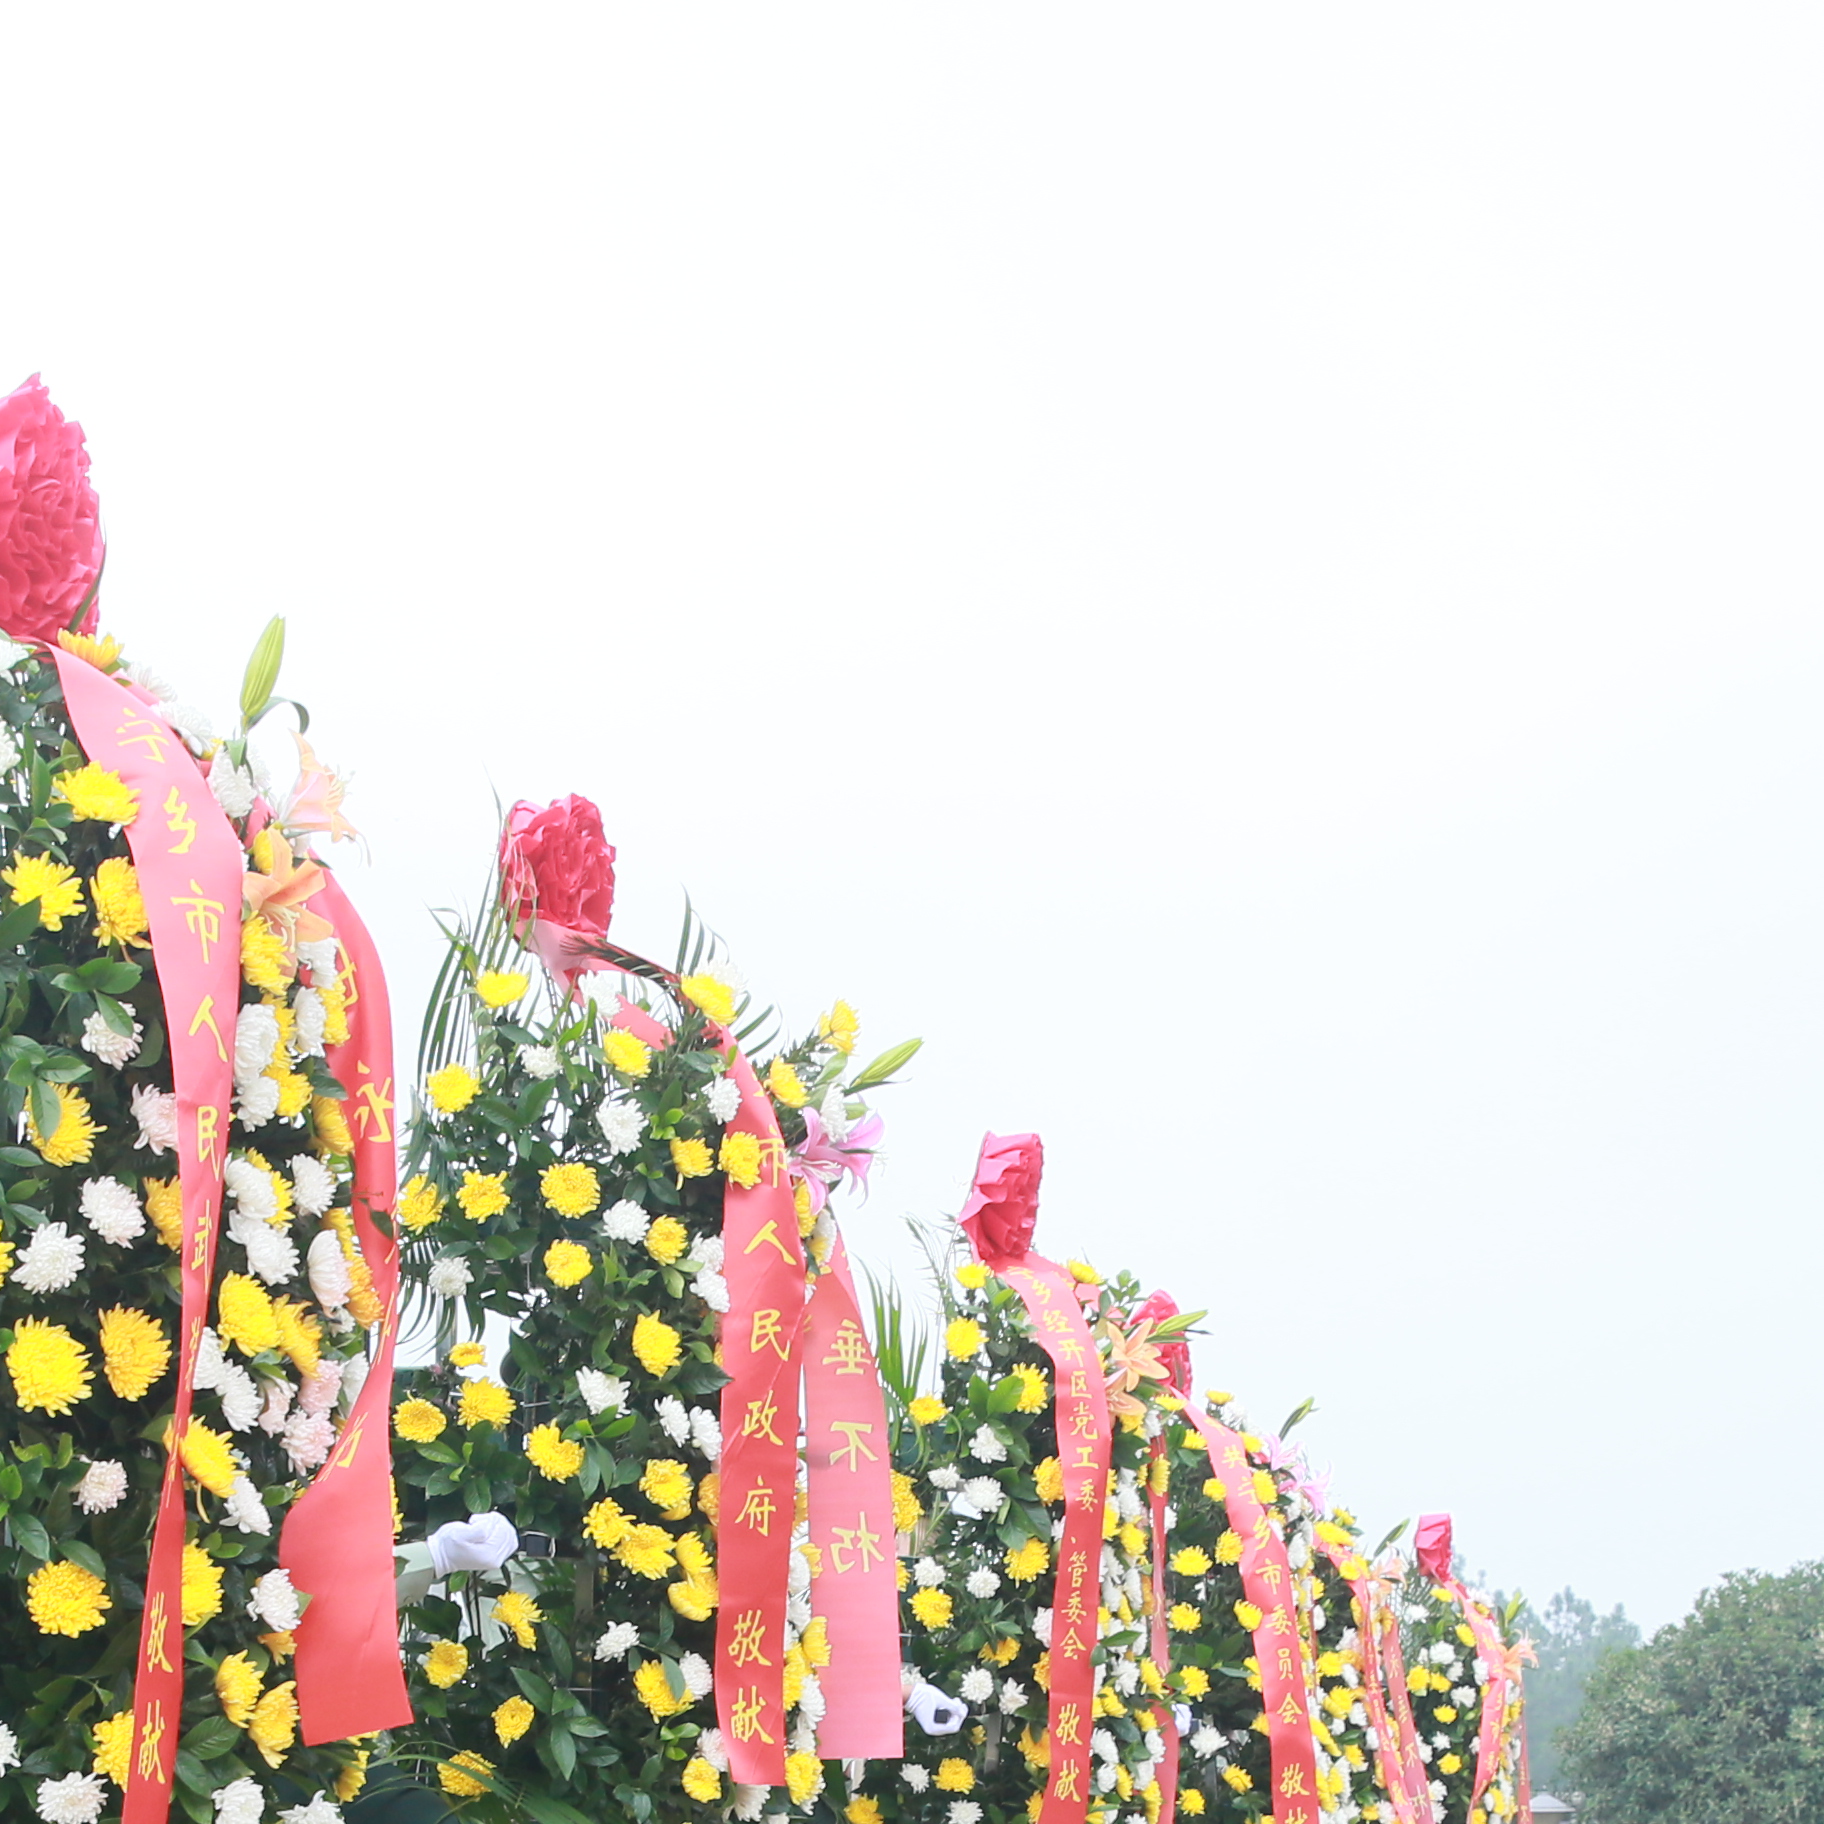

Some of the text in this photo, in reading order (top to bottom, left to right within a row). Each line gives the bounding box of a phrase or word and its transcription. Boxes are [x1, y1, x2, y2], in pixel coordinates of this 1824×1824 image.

[727, 1073, 797, 1746] 市人民政府 敬献
[136, 1591, 175, 1785] 敬献
[1203, 1415, 1304, 1727] 中共宁乡市委员会
[1054, 1702, 1084, 1804] 敬献
